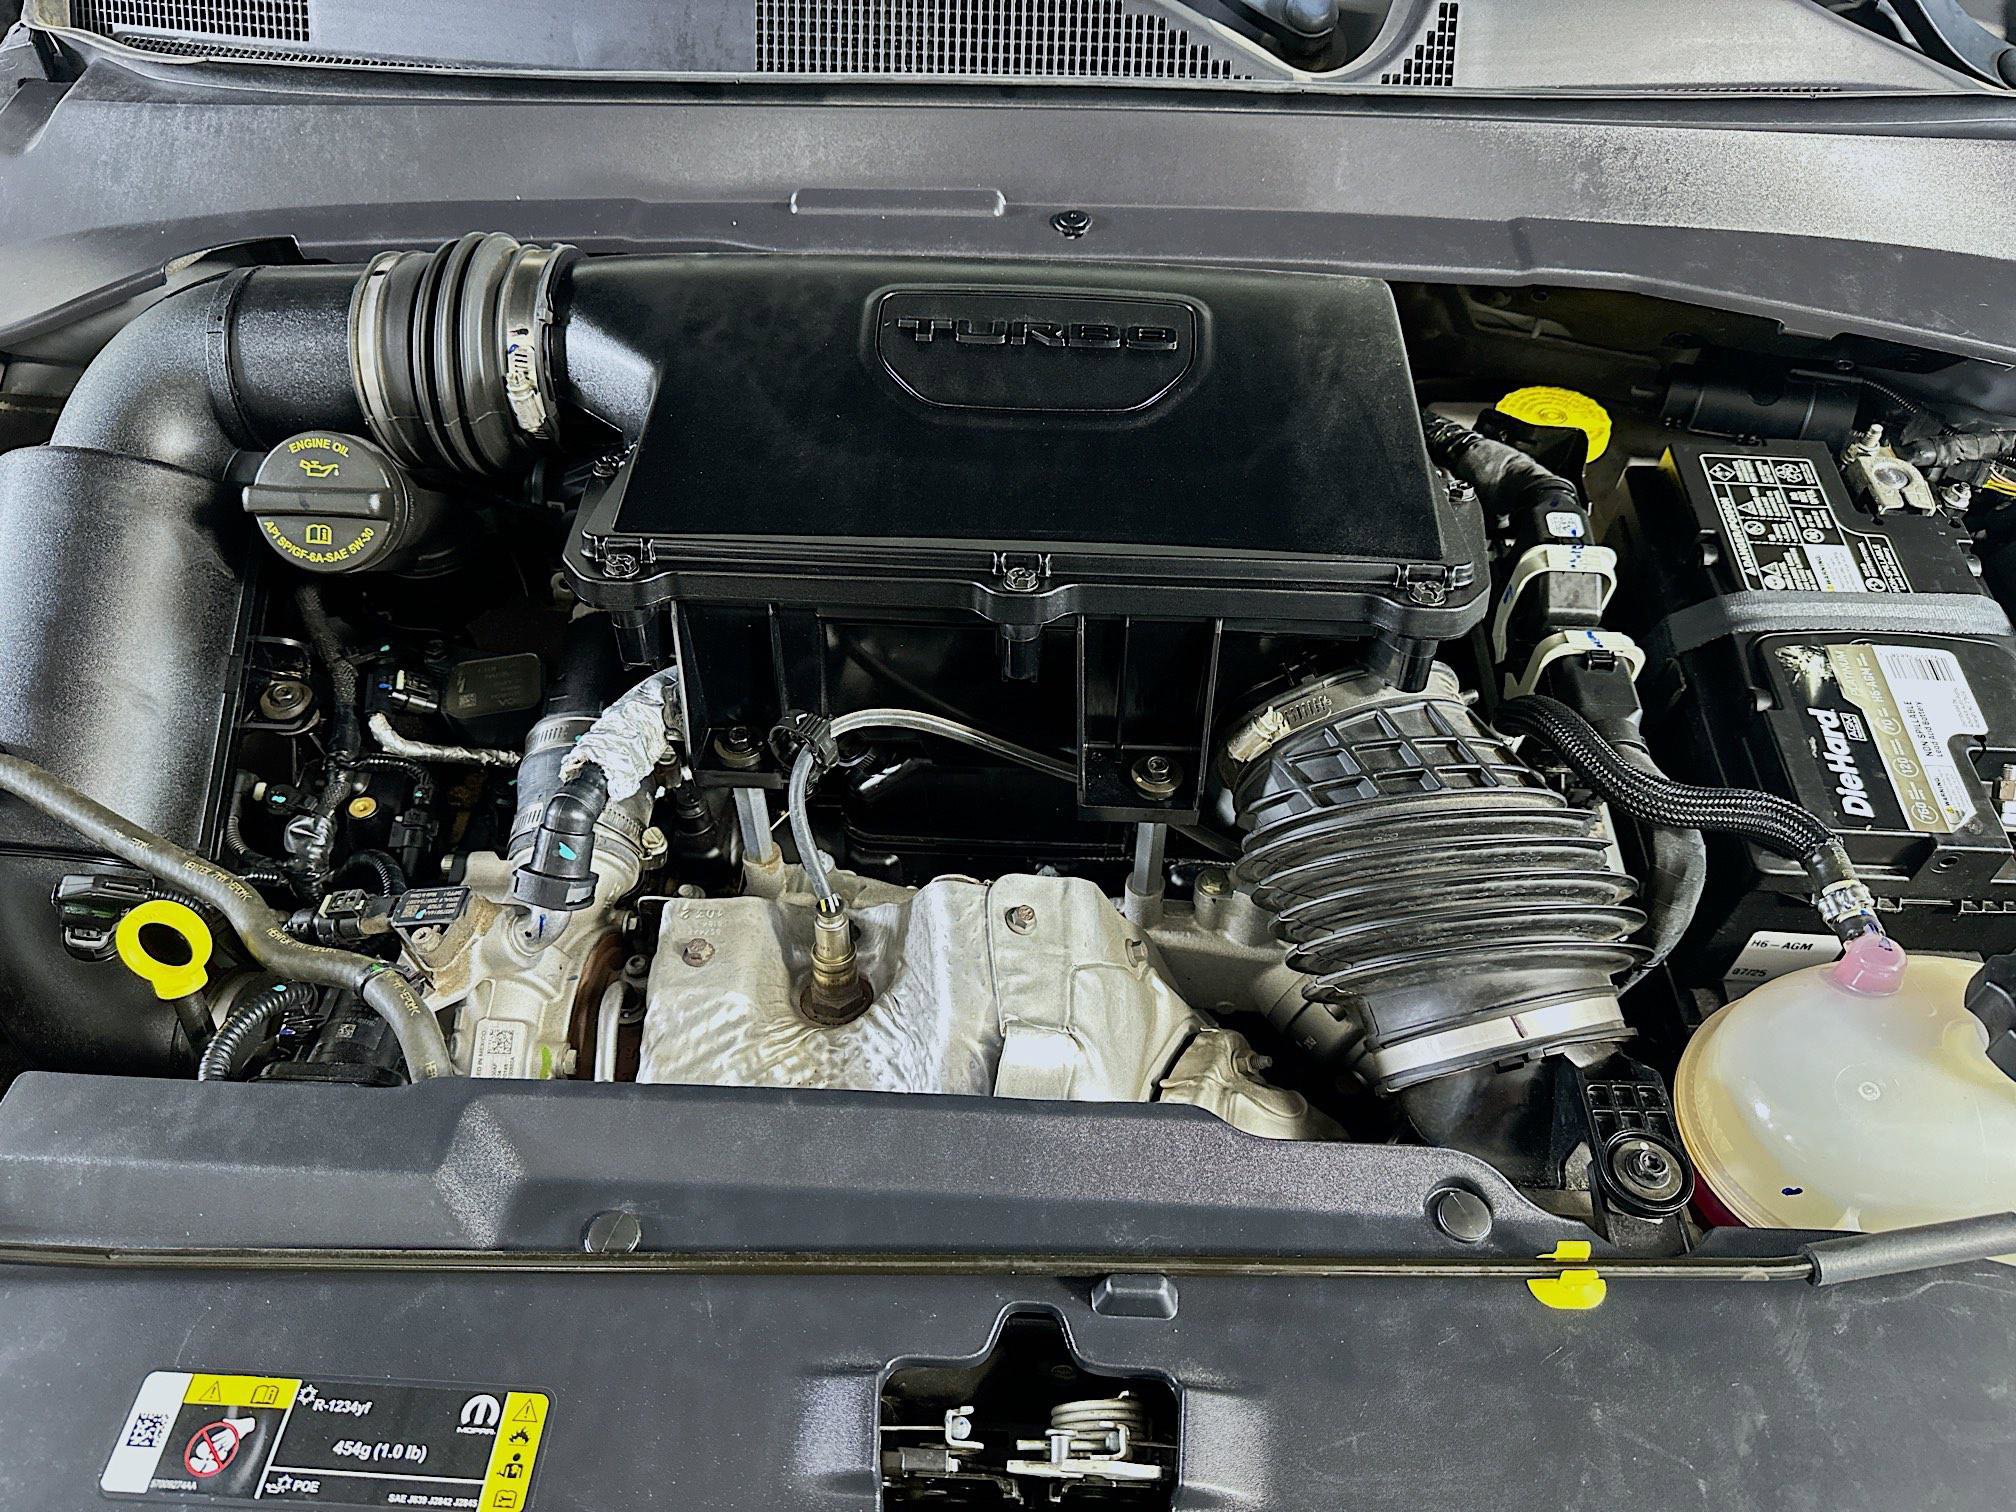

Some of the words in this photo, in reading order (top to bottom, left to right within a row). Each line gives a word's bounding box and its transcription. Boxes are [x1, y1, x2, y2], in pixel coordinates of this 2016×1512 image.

[898, 317, 1178, 351] TURBO
[288, 438, 332, 454] ENGINE
[332, 442, 349, 458] OIL
[264, 520, 281, 540] API
[349, 527, 375, 553] 5W-30
[1904, 701, 1926, 740] SPILLABLE
[1922, 741, 1934, 757] NON
[1807, 707, 1876, 818] DieHard
[1751, 940, 1768, 948] H6
[1781, 942, 1814, 951] AGM
[312, 1399, 373, 1417] R-1234yf
[332, 1440, 371, 1461] 454g
[373, 1442, 404, 1462] (1.0
[405, 1444, 428, 1464] lb)
[291, 1480, 321, 1494] POE
[388, 1493, 408, 1504] SAE
